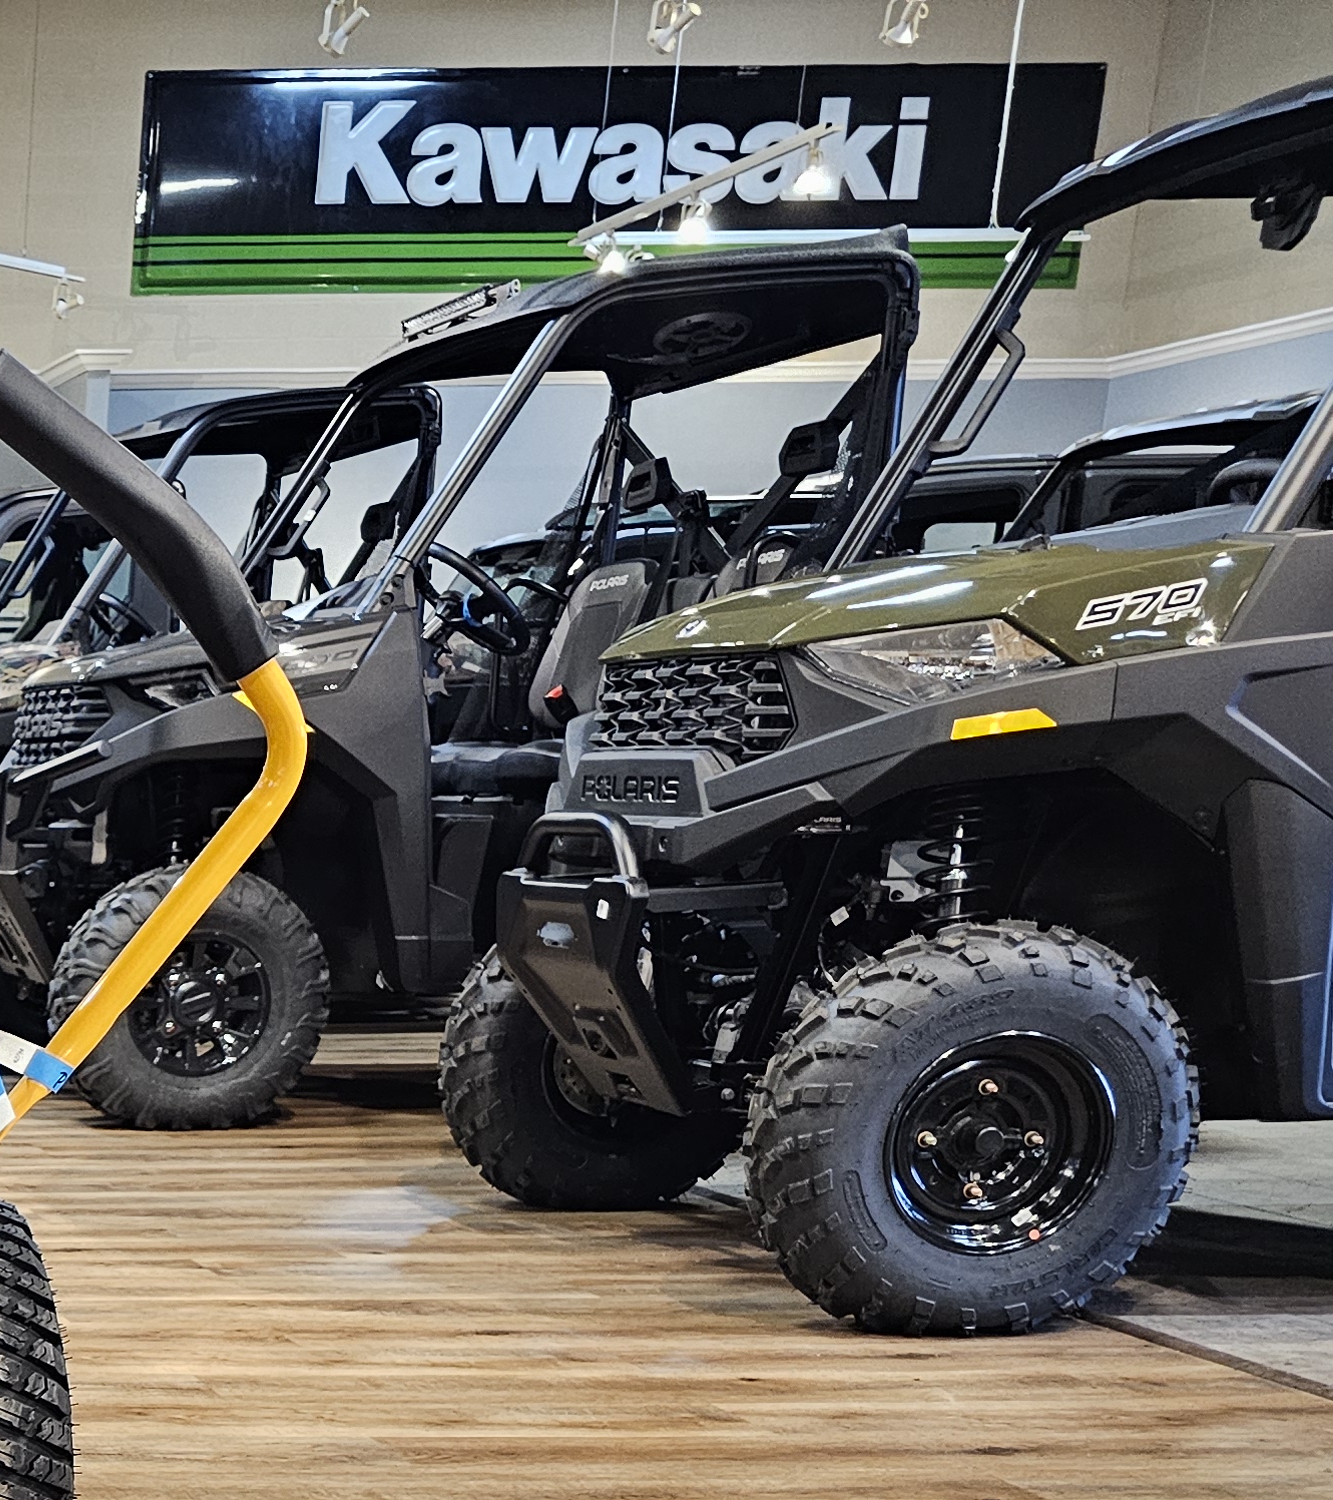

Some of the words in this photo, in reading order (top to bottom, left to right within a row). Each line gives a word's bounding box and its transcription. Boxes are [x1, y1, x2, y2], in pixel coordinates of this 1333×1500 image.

[315, 97, 930, 205] Kawasaki
[589, 574, 630, 592] POLARIS
[1075, 577, 1208, 630] 570
[1152, 605, 1203, 626] EFI
[579, 774, 680, 804] POLARIS
